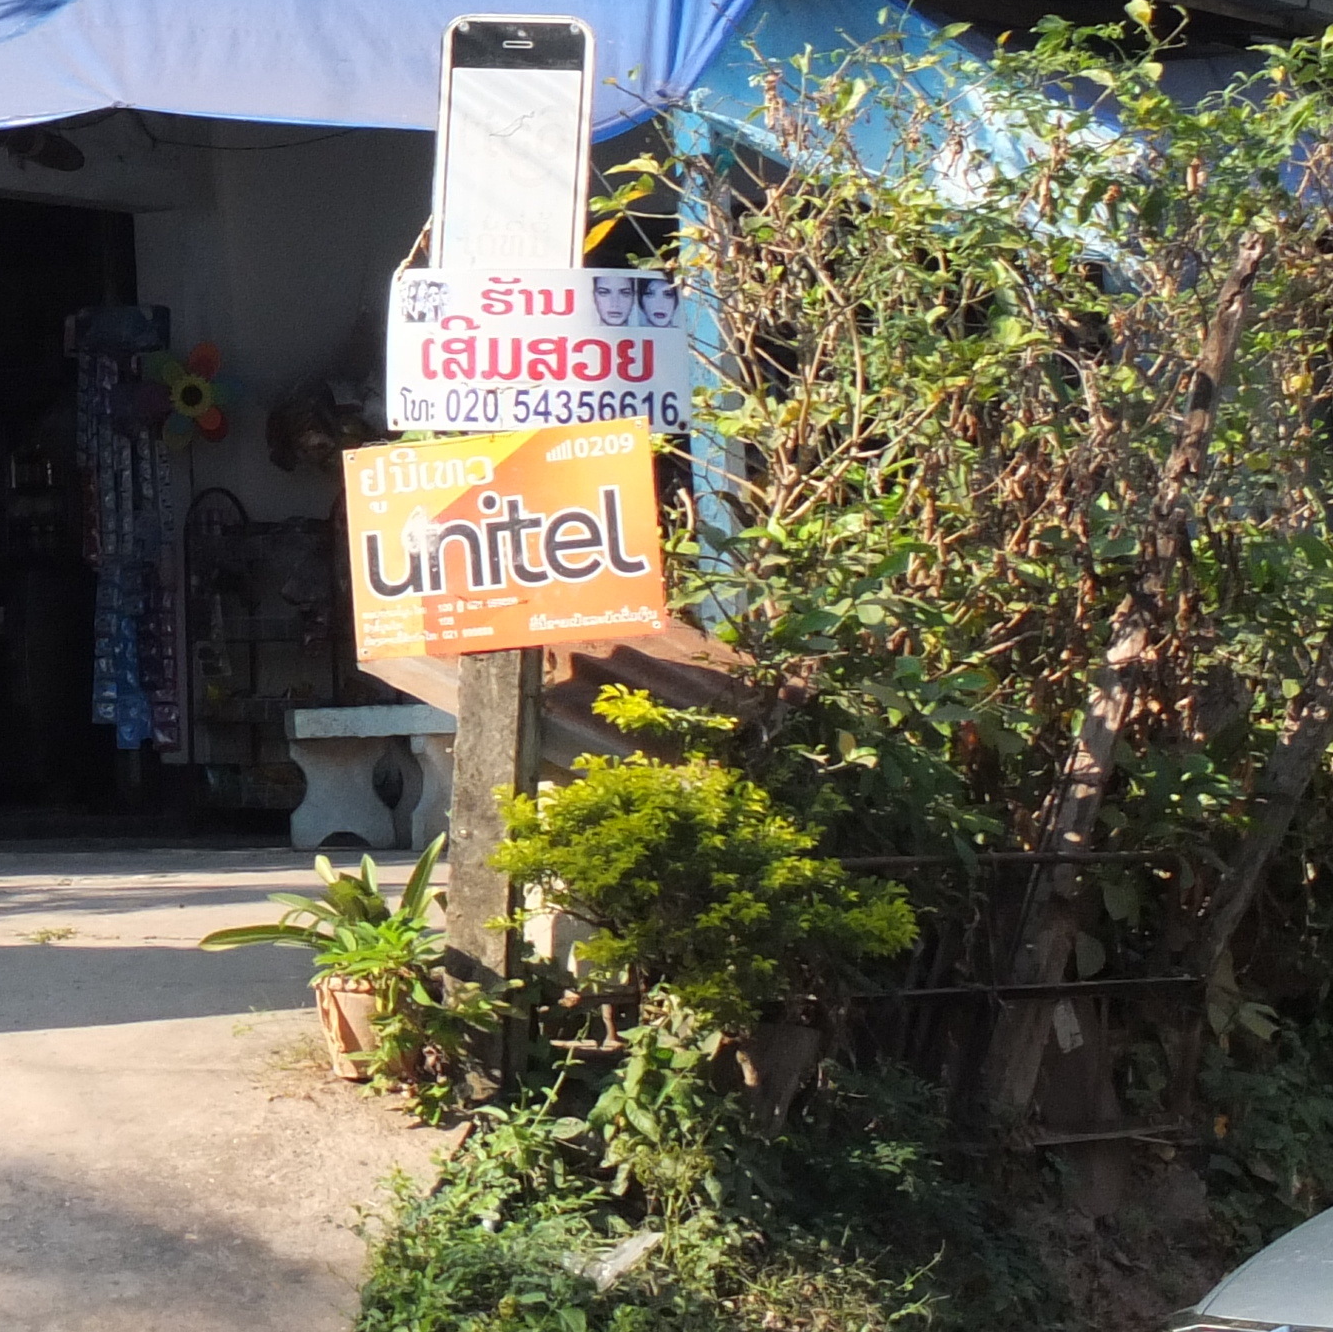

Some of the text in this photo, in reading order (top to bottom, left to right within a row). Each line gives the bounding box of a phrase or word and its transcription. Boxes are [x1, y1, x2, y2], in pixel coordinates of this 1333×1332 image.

[481, 276, 575, 316] ຮ້ານ
[446, 388, 499, 423] 020
[513, 390, 680, 427] 54356616
[574, 433, 634, 460] 0209
[363, 486, 649, 599] unitel
